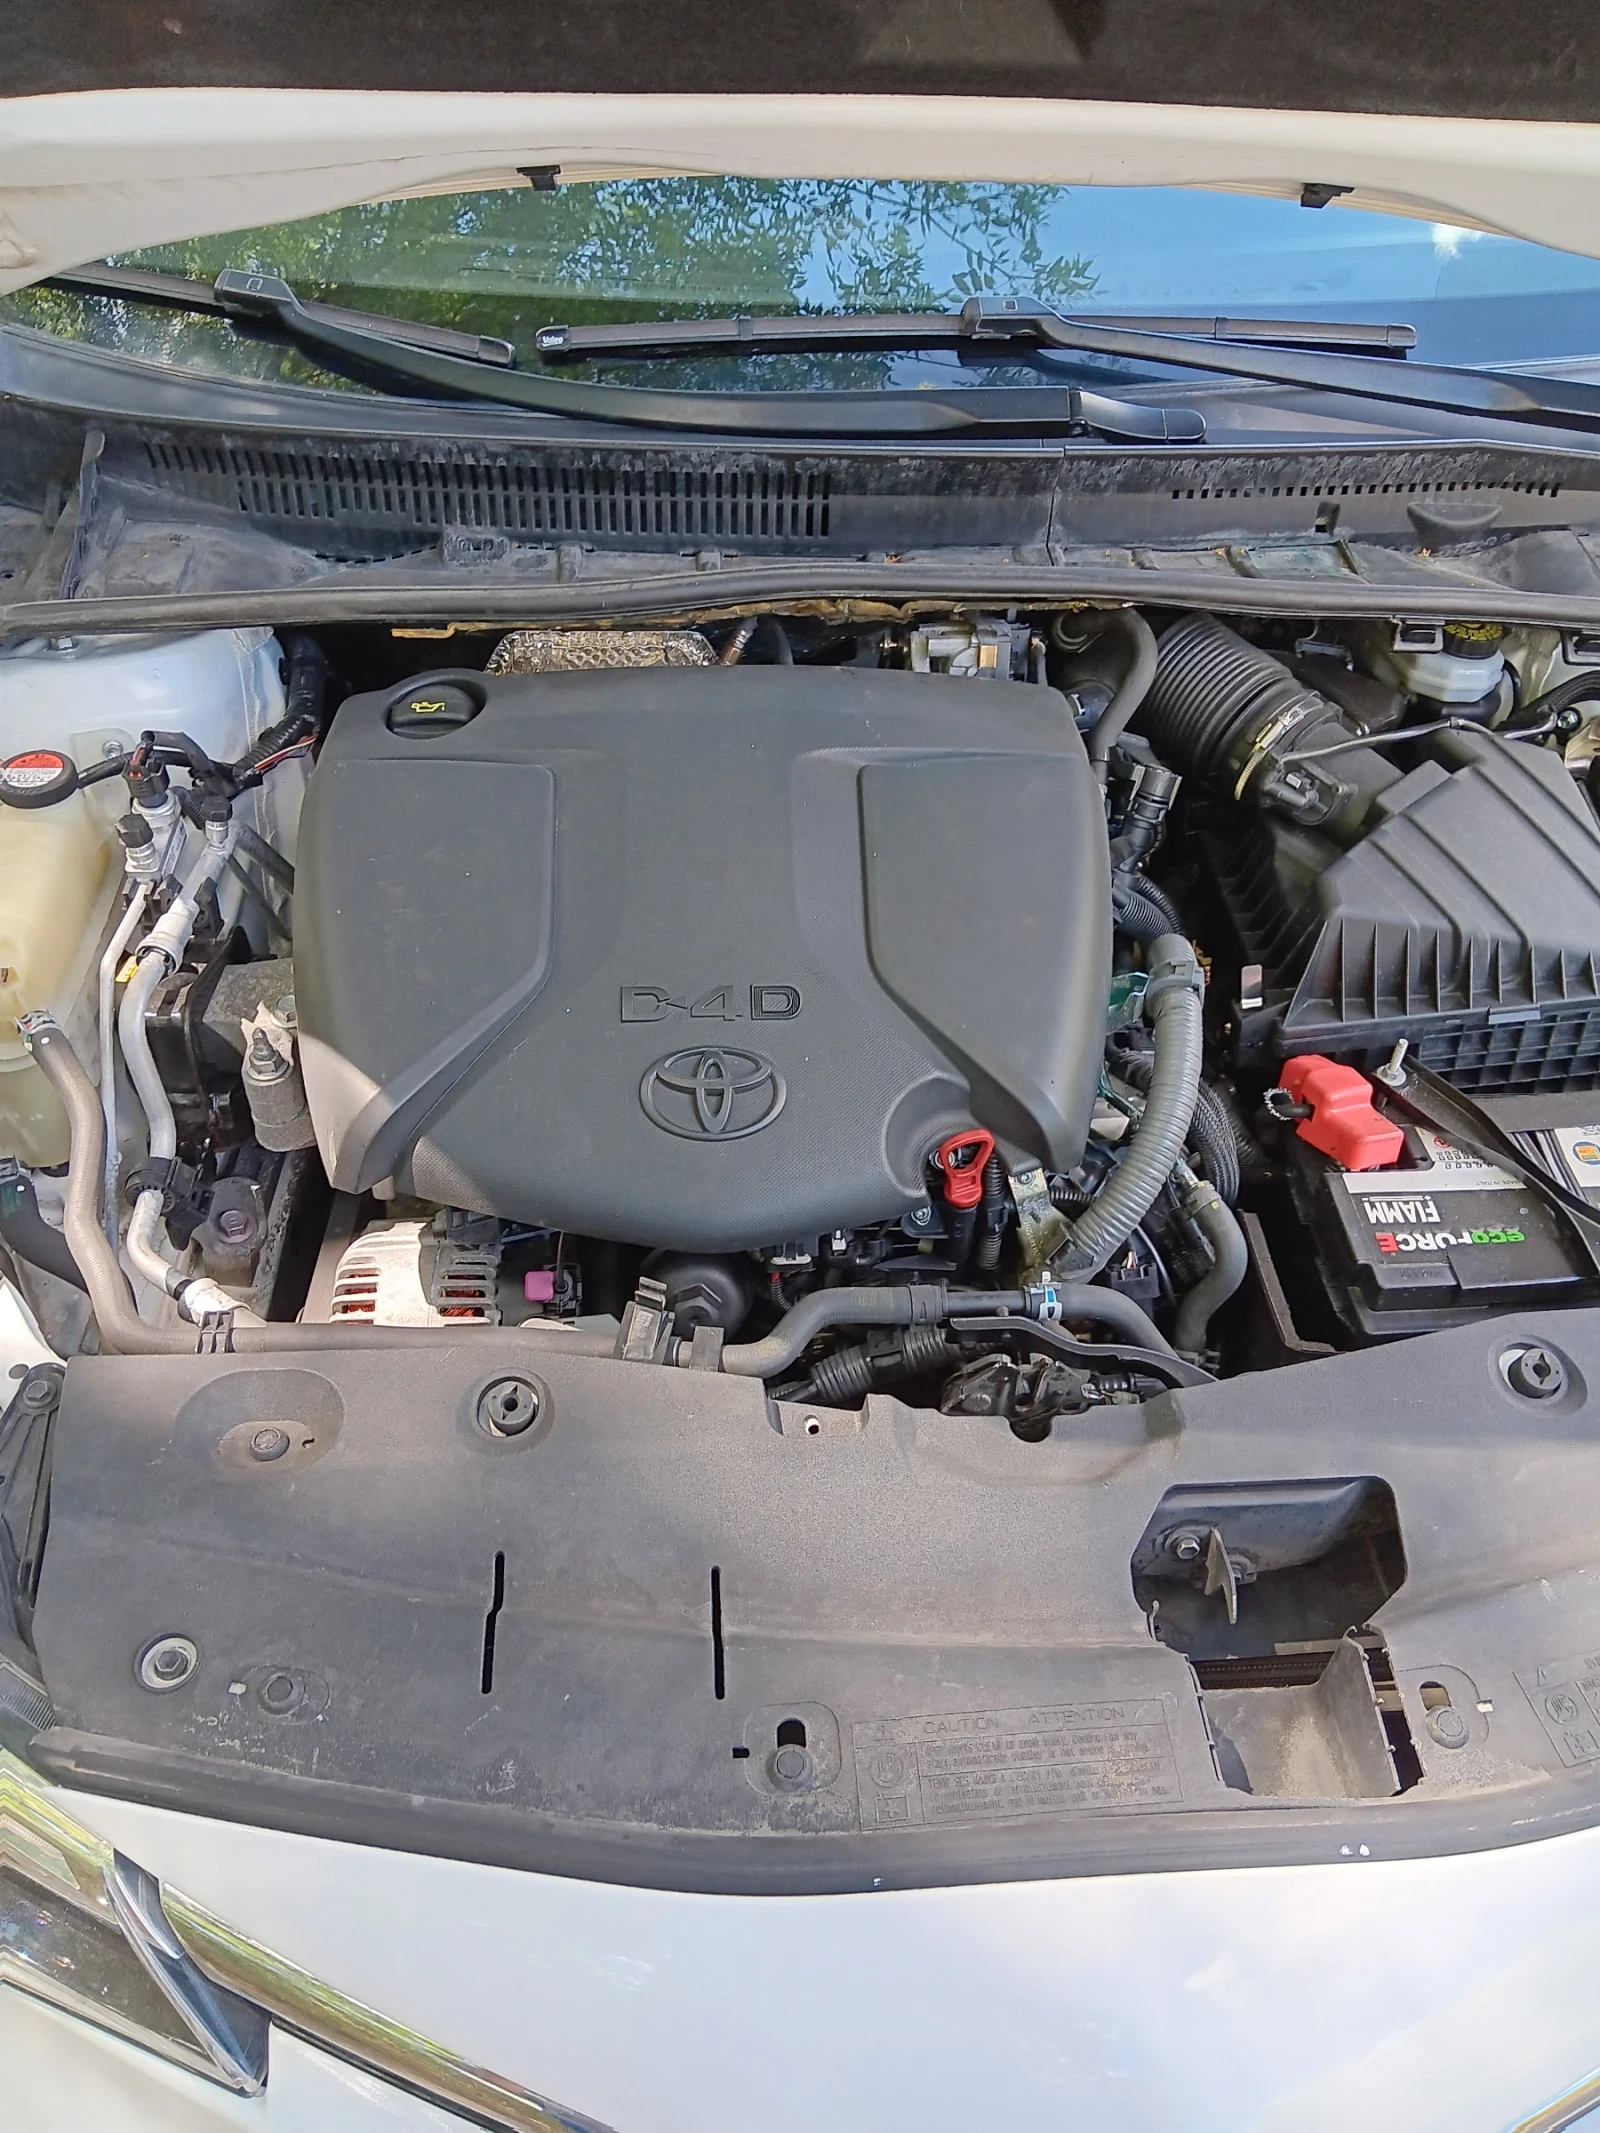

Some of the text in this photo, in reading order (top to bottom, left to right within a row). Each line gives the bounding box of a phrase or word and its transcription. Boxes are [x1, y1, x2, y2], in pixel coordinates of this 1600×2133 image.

[620, 984, 803, 1023] D-4D
[1365, 1200, 1441, 1224] FIAMM
[922, 1706, 1125, 1734] CAUTION ATTENTION
